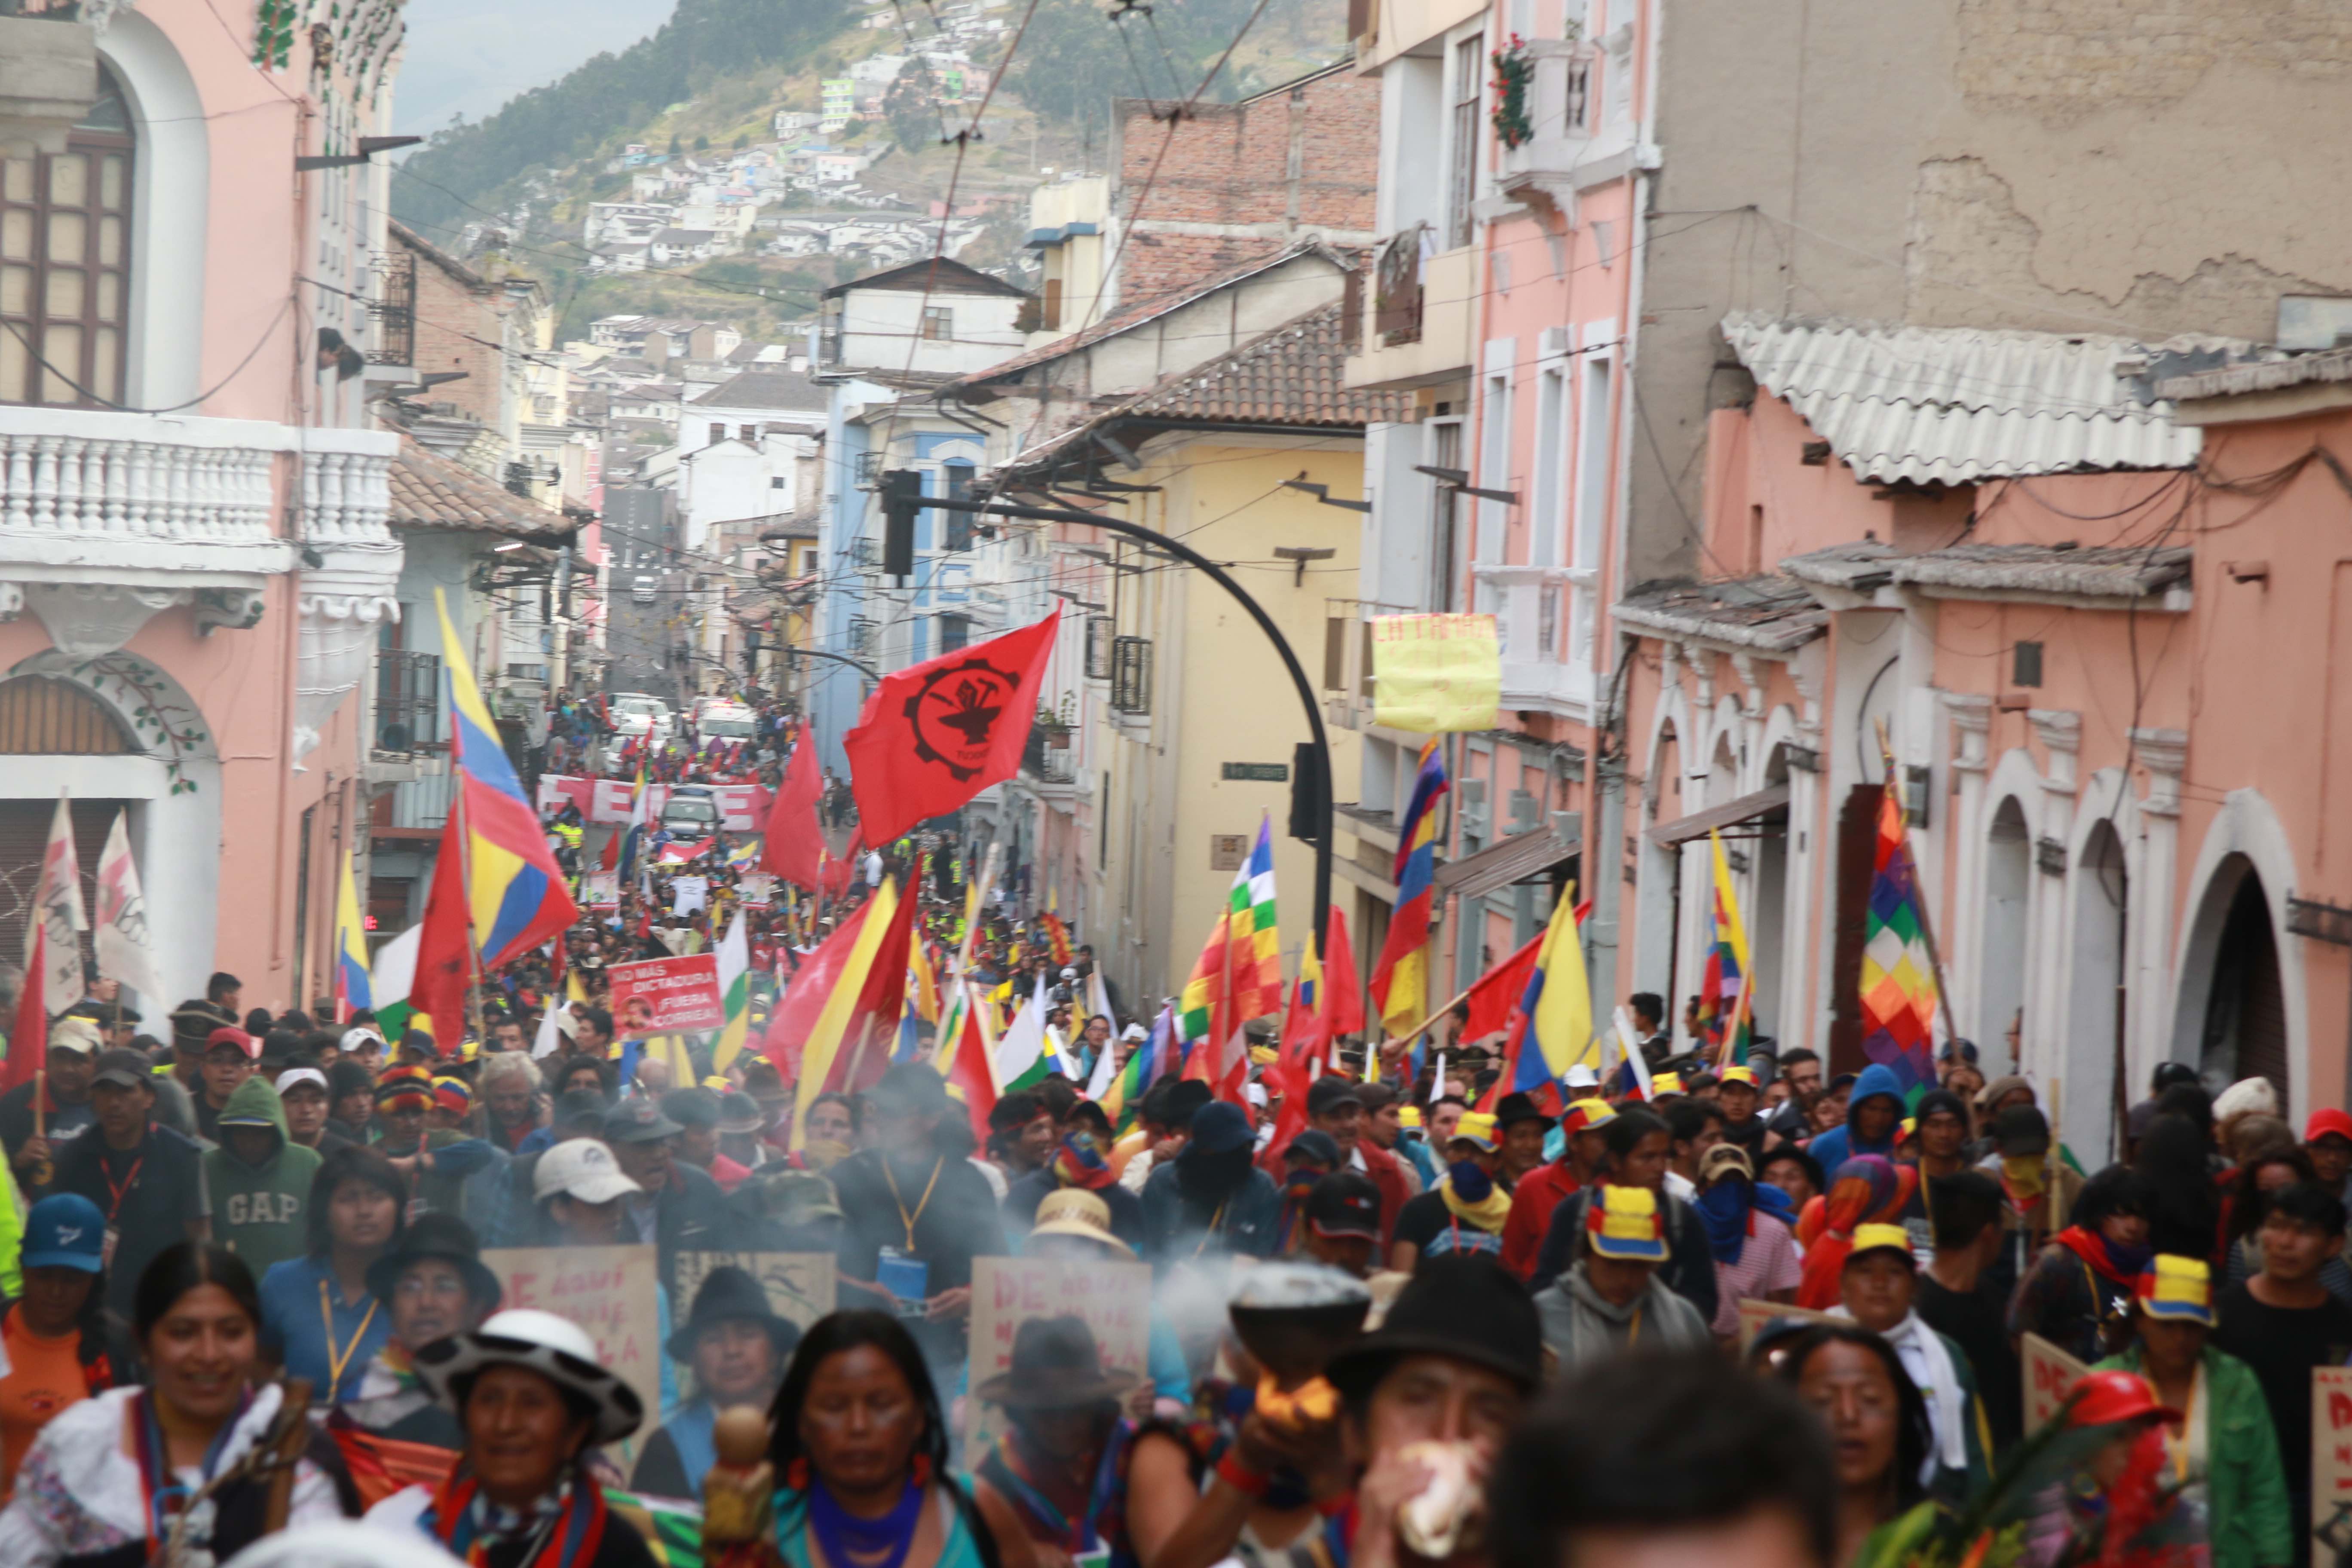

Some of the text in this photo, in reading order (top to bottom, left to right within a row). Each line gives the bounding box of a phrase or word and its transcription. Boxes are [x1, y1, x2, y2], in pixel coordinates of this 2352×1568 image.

[612, 965, 667, 981] NO MÁS
[632, 972, 715, 993] DICTADURA
[658, 993, 710, 1012] ¡FUERA
[227, 1191, 300, 1225] GAP
[994, 1269, 1047, 1311] DE
